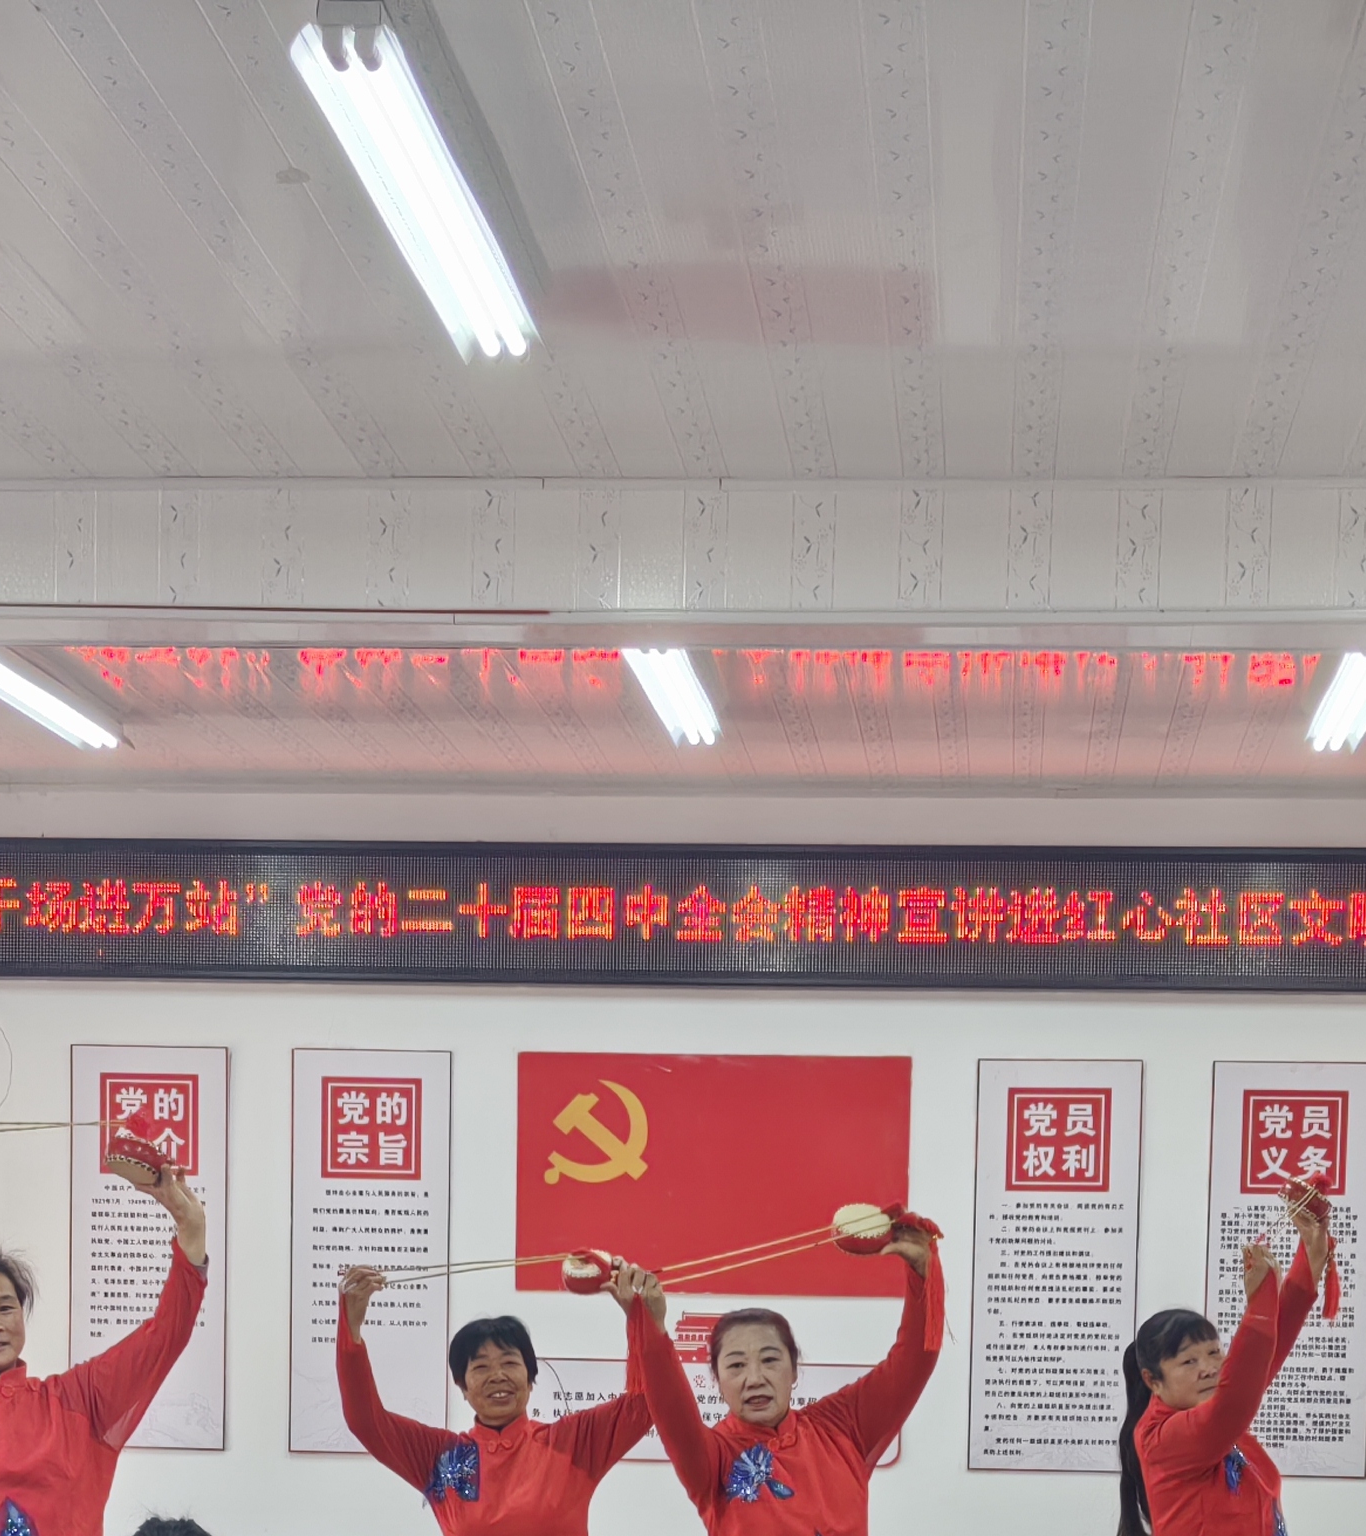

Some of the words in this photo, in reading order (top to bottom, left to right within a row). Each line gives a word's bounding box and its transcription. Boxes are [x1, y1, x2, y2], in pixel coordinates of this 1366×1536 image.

[115, 1086, 185, 1122] 党的
[337, 1091, 408, 1126] 党的
[1023, 1102, 1096, 1138] 党员
[1259, 1104, 1332, 1139] 党员
[115, 1126, 185, 1160] 介
[336, 1129, 408, 1167] 宗旨
[1022, 1142, 1096, 1178] 权利
[1257, 1145, 1332, 1180] 义务
